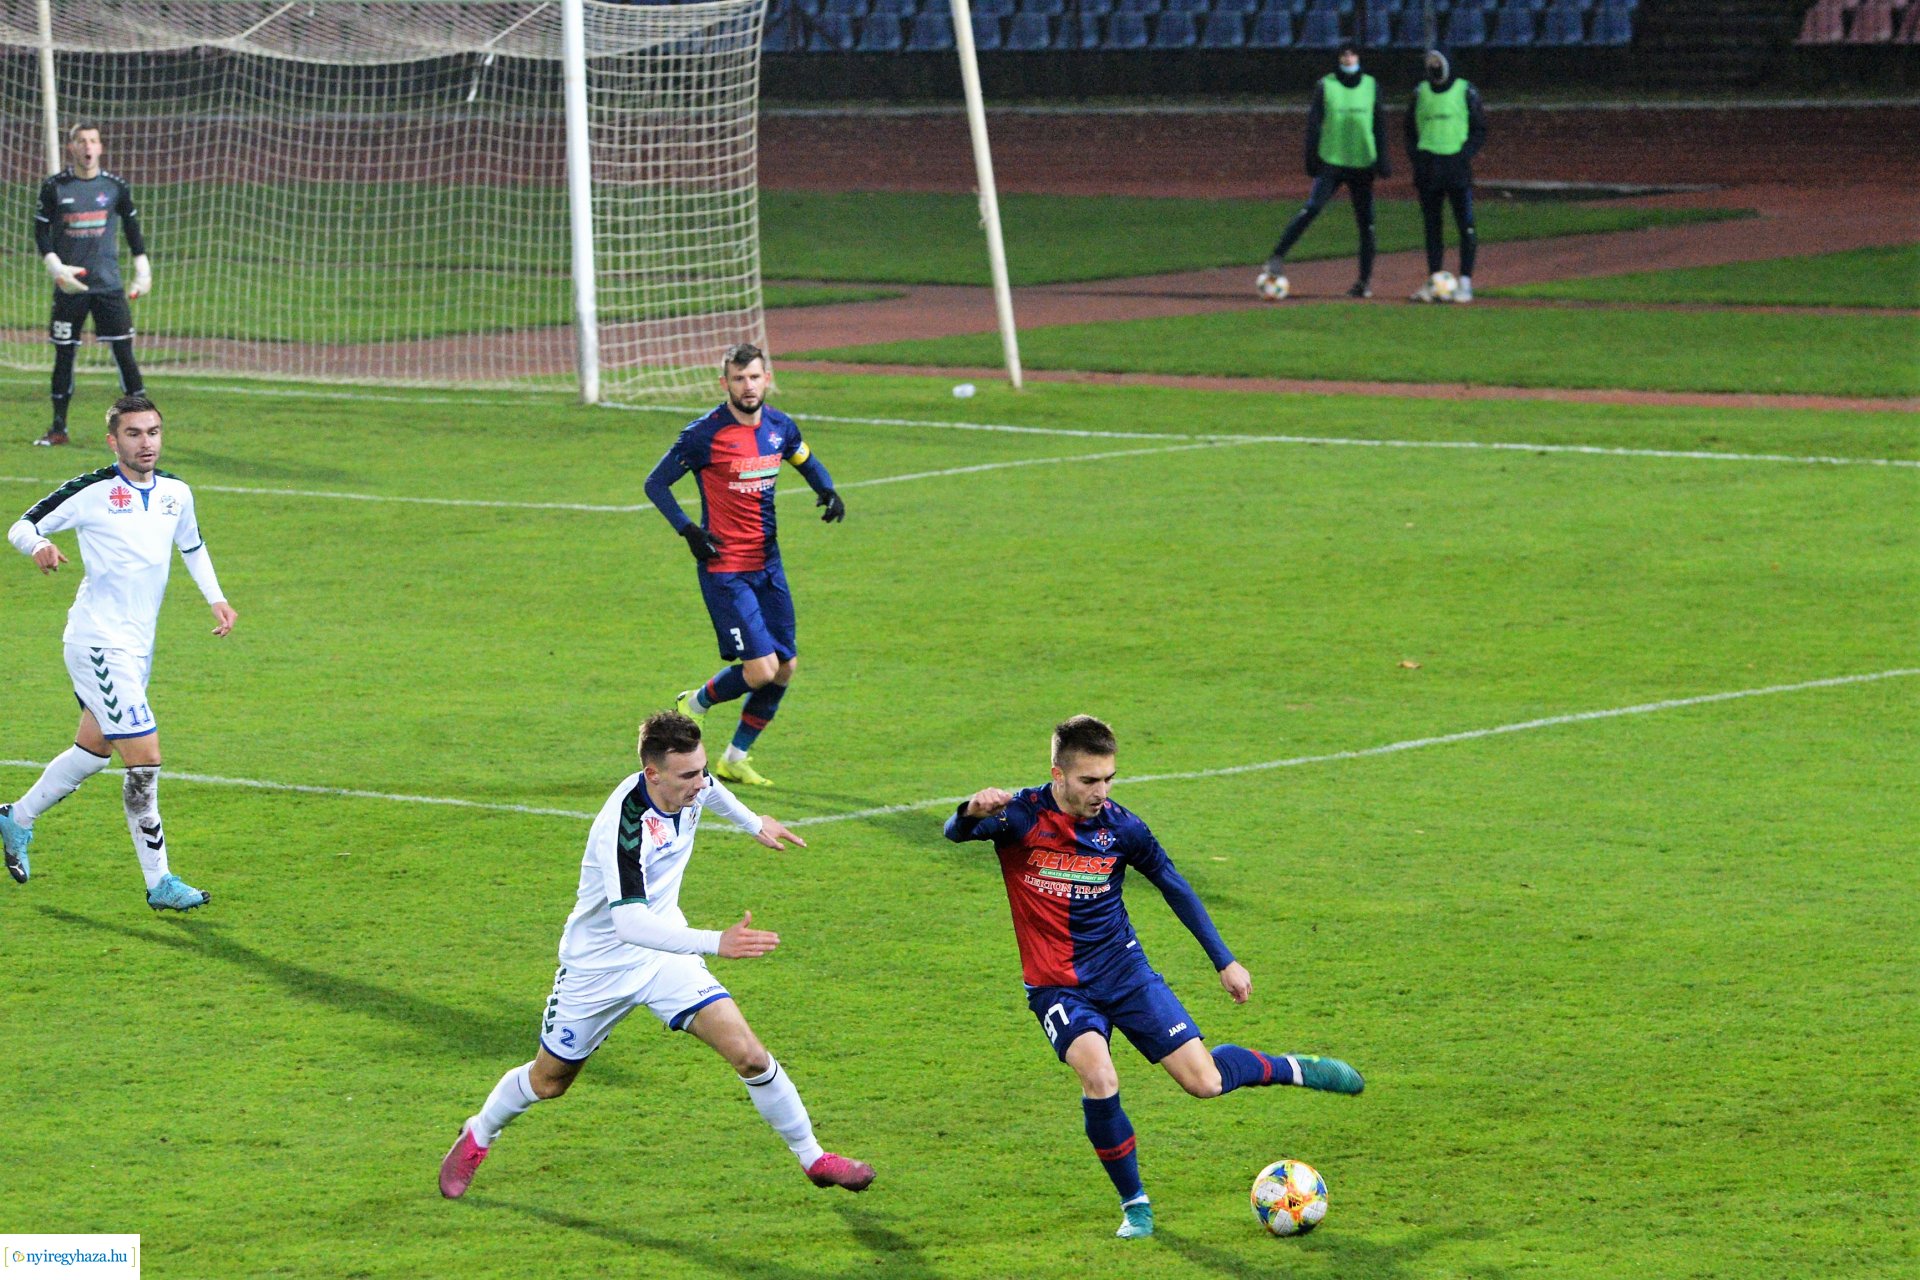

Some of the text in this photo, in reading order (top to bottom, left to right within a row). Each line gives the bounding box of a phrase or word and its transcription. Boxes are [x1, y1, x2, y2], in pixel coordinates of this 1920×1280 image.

[53, 321, 73, 339] 95
[730, 627, 745, 651] 3
[128, 704, 151, 727] 11
[1027, 849, 1117, 874] REVESZ
[1074, 883, 1111, 895] TRANS
[1044, 1003, 1070, 1044] 97
[1168, 1022, 1187, 1037] JAKO
[560, 1026, 577, 1049] 2
